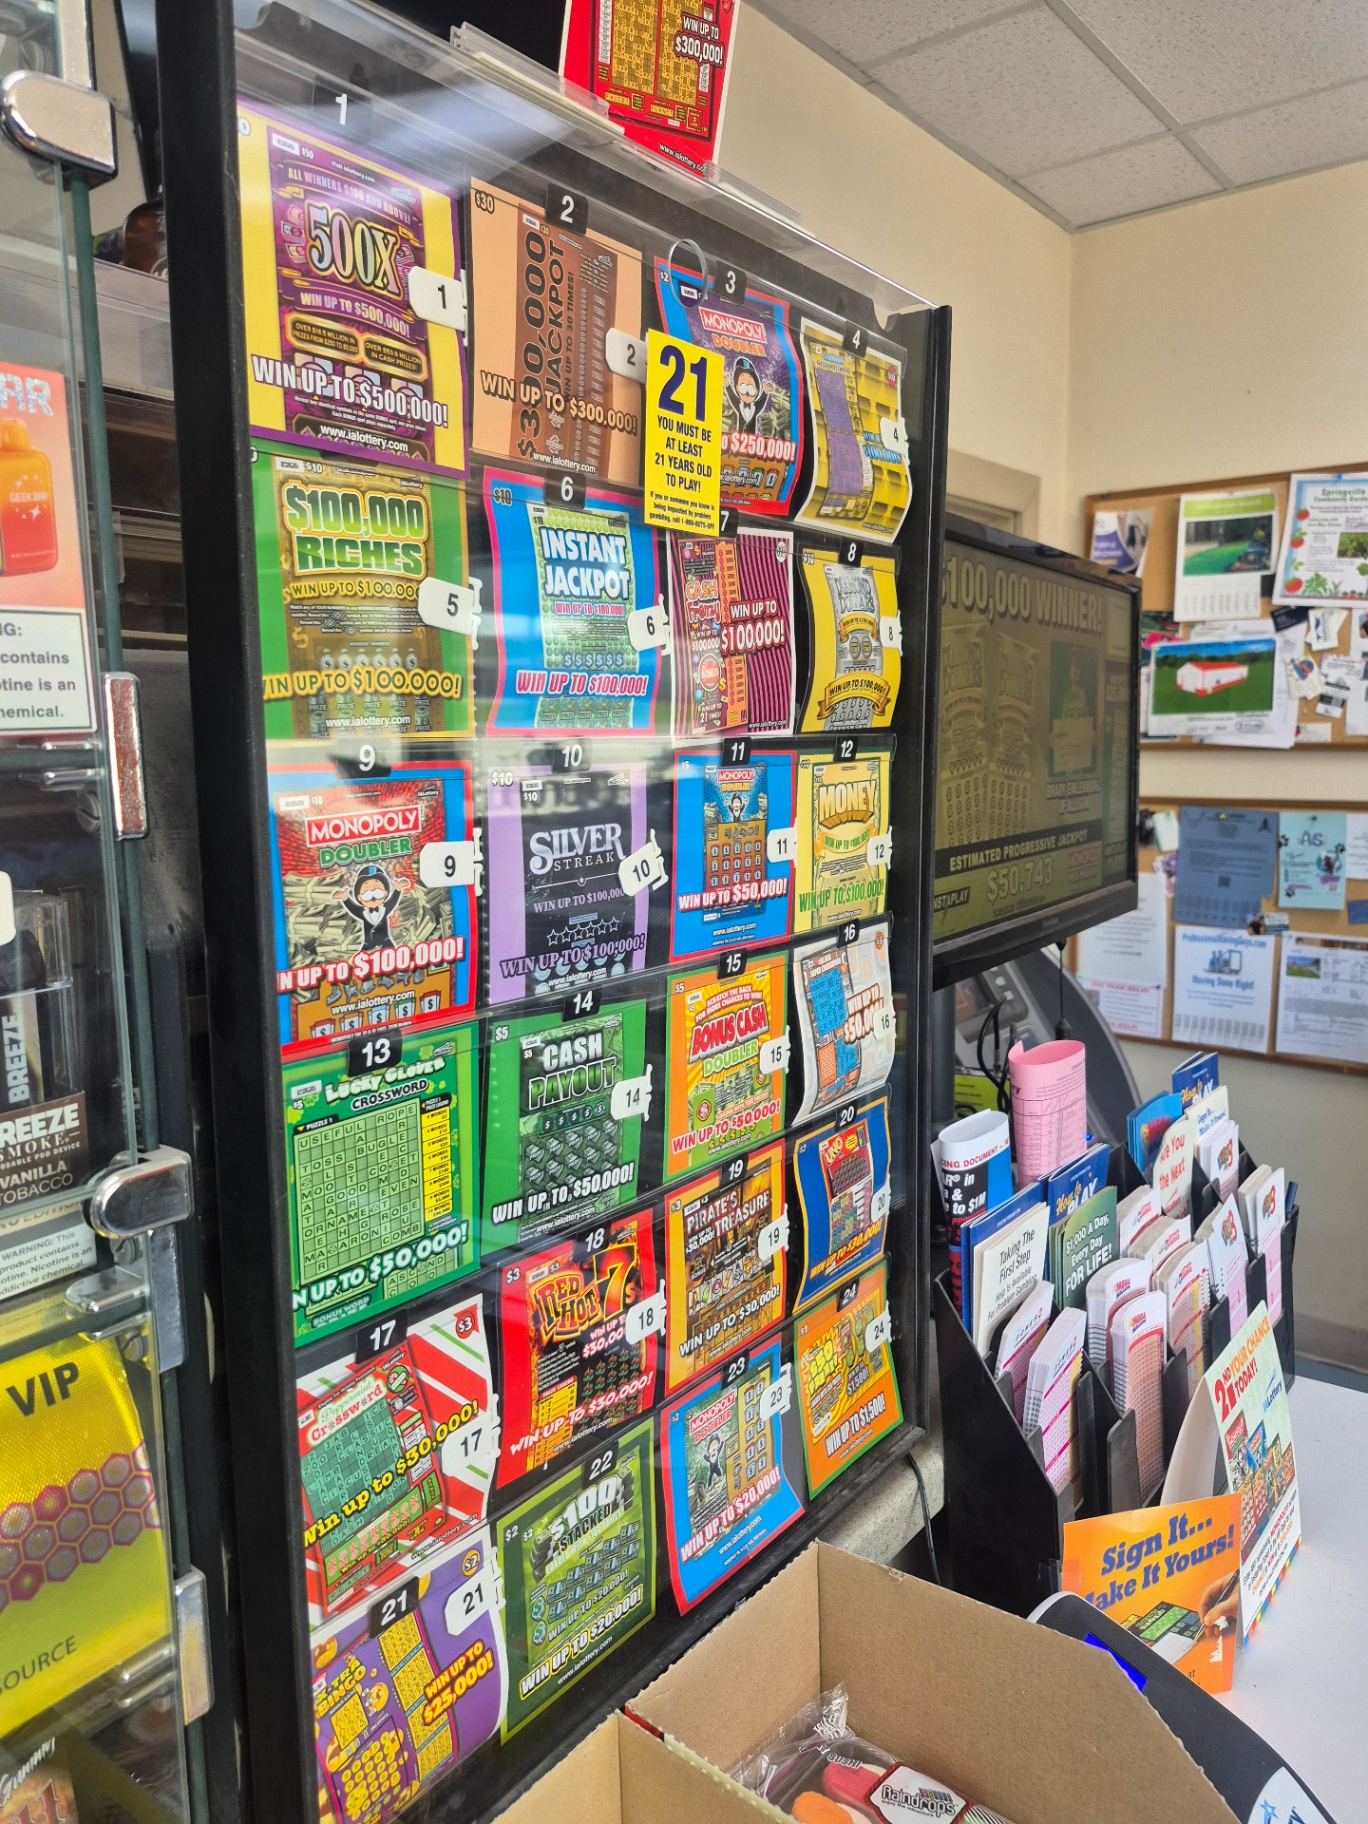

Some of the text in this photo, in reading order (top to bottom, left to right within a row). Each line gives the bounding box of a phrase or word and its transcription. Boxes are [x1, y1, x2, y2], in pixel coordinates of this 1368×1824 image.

[683, 16, 719, 39] WIN UP TO
[676, 36, 723, 65] $300,000!
[336, 93, 348, 126] 1
[475, 191, 495, 213] $30
[560, 195, 575, 223] 2
[307, 202, 401, 296] 500X
[725, 270, 736, 294] 3
[546, 239, 565, 393] JACKPOT
[702, 313, 764, 342] MONOPOLY
[712, 334, 766, 357] DOUBLER
[852, 330, 860, 348] 4
[251, 355, 297, 389] WIN
[300, 370, 327, 397] UP
[330, 376, 355, 402] TO
[358, 381, 449, 428] $500,000!
[657, 344, 708, 422] 21
[320, 424, 408, 452] www.ialottery.com
[657, 415, 712, 442] YOU MUST BE
[665, 438, 704, 458] AT LEAST
[731, 431, 796, 462] $250,000!
[654, 453, 712, 478] 21 YEARS OLD
[10, 492, 48, 502] GEEK BAR
[560, 477, 573, 501] 6
[665, 474, 701, 493] TO PLAY!
[286, 482, 425, 538] $100,000
[721, 511, 729, 531] 7
[296, 536, 424, 576] RICHES
[540, 528, 626, 565] INSTANT
[848, 543, 856, 561] 8
[545, 566, 630, 599] JACKPOT
[686, 580, 718, 600] CASH
[446, 594, 458, 617] 5
[730, 599, 777, 619] WIN UP TO
[722, 620, 784, 652] $100,000!
[0, 651, 69, 664] contains
[39, 678, 76, 691] is an
[359, 745, 375, 771] 9
[562, 745, 583, 768] 10
[731, 742, 745, 761] 11
[841, 741, 853, 758] 12
[818, 780, 876, 823] MONEY
[311, 809, 417, 843] MONOPOLY
[319, 838, 412, 867] DOUBLER
[530, 823, 626, 875] SILVER
[554, 852, 615, 871] STREAK
[950, 829, 1087, 872] ESTIMATED PROGRESSIVE JACKPOT
[986, 857, 1053, 900] $50,743
[799, 880, 884, 912] WIN UP TO $100,000!
[844, 924, 855, 941] 16
[725, 954, 741, 974] 15
[1192, 975, 1214, 987] Moving
[1217, 976, 1233, 987] Done
[573, 991, 593, 1014] 14
[692, 1002, 767, 1056] BONUS CASH
[1, 1015, 29, 1104] BREEZE
[361, 1038, 391, 1068] 13
[543, 1033, 603, 1071] CASH
[703, 1041, 759, 1078] DOUBLER
[350, 1079, 429, 1112] CROSSWORD
[529, 1057, 616, 1111] PAYOUT
[0, 1103, 80, 1148] REEZE
[840, 1106, 854, 1127] 20
[825, 1137, 843, 1165] UNO
[963, 1148, 998, 1167] DOCUMENT
[0, 1160, 67, 1190] VANILLA
[728, 1160, 744, 1180] 19
[1170, 1158, 1185, 1184] Next
[0, 1172, 74, 1205] TOBACCO
[687, 1191, 738, 1234] PIRATE'S
[715, 1190, 769, 1237] TREASURE
[1, 1232, 76, 1261] WARNING: This
[585, 1228, 604, 1253] 18
[1000, 1229, 1035, 1266] Taking The
[1066, 1214, 1109, 1254] $1,000 A Day,
[1000, 1249, 1031, 1283] First Step
[1072, 1235, 1103, 1267] Every Day
[1066, 1243, 1112, 1297] FOR LIFE!
[537, 1275, 579, 1327] RED
[842, 1283, 857, 1305] 24
[557, 1291, 596, 1331] HOT
[369, 1320, 396, 1350] 17
[1229, 1315, 1270, 1377] YOUR CHANCE
[727, 1357, 746, 1381] 23
[1235, 1357, 1258, 1398] TODAY!
[6, 1362, 80, 1417] VIP
[690, 1392, 735, 1432] MONOPOLY
[694, 1411, 732, 1444] DOUBLER
[304, 1400, 479, 1549] Win up to $30,000!
[589, 1450, 613, 1480] 22
[550, 1475, 619, 1542] $100
[560, 1502, 611, 1552] STACKED
[1101, 1512, 1213, 1576] Sign It...
[1141, 1566, 1160, 1588] It
[1163, 1525, 1235, 1579] Yours!
[381, 1595, 408, 1626] 21
[425, 1642, 483, 1698] WIN UP TO
[557, 1635, 613, 1685] www.ialottery.com
[319, 1666, 366, 1717] BINGO
[424, 1650, 493, 1723] $25,000!
[827, 1752, 862, 1770] SUSHI
[882, 1784, 956, 1818] Raindrops
